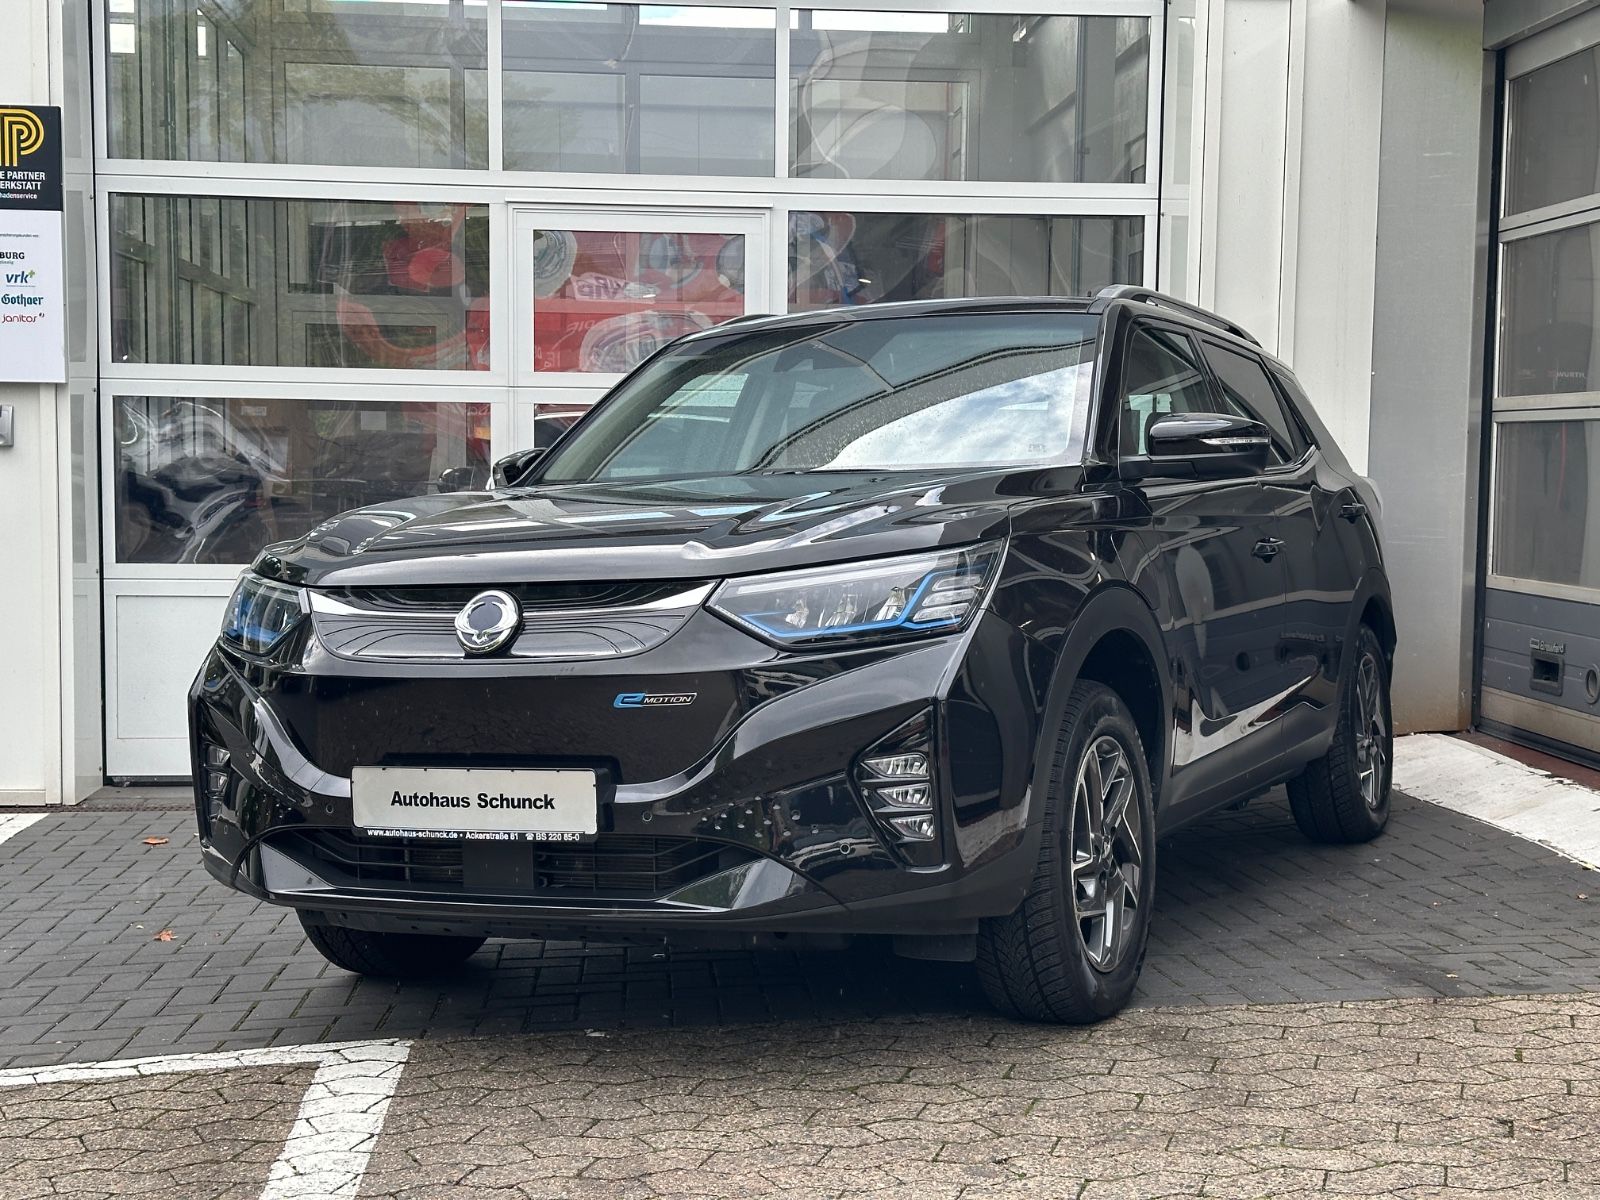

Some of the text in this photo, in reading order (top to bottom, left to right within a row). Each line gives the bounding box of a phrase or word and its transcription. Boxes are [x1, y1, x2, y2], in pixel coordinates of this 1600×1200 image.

[7, 171, 46, 180] PARTNER
[0, 181, 42, 190] ERKSTATT
[1, 294, 44, 307] Gothaer
[643, 696, 692, 704] MOTION
[391, 791, 555, 809] Autohaus Schunck
[367, 829, 458, 838] www.autohaus-schunck.de
[465, 831, 508, 840] Ackerstraße
[535, 833, 547, 841] BS
[548, 833, 562, 841] 220
